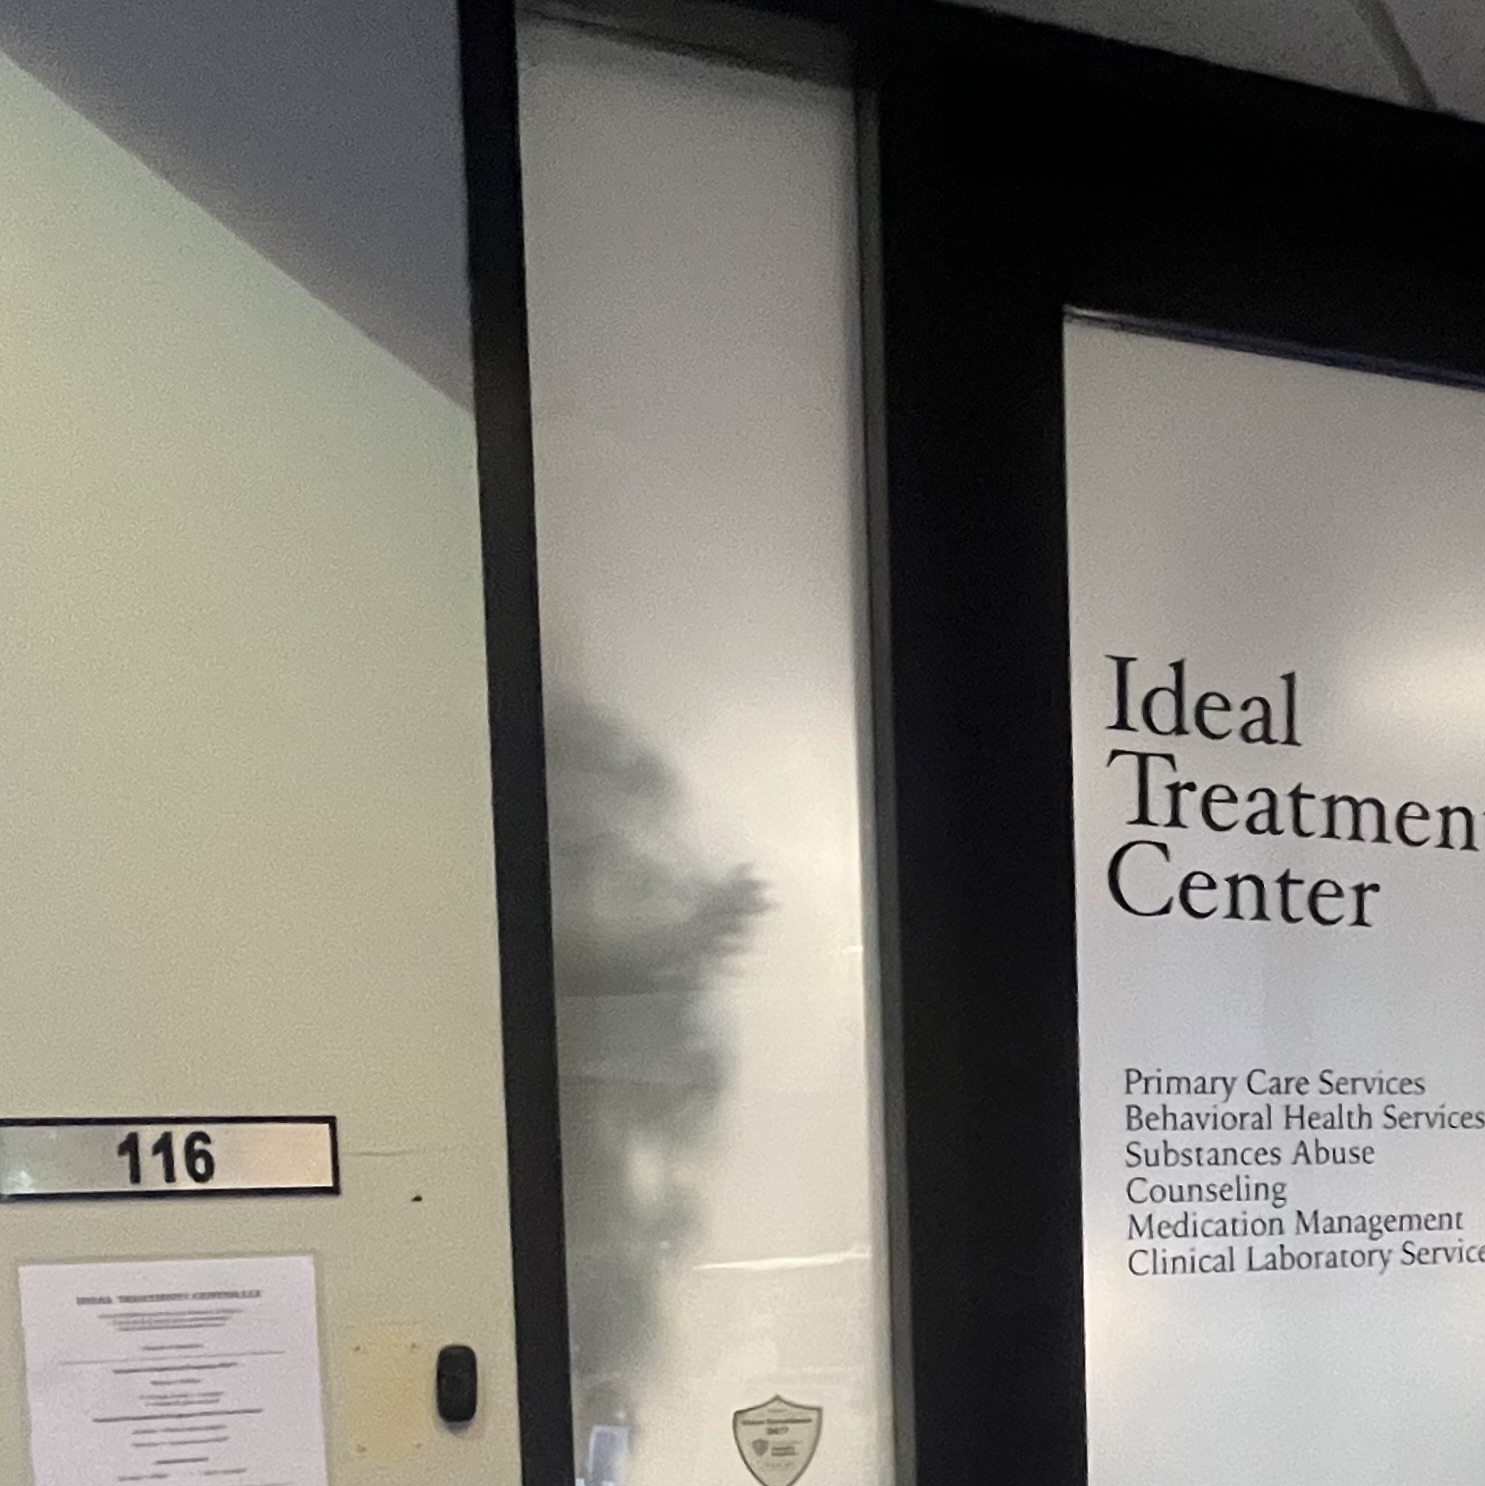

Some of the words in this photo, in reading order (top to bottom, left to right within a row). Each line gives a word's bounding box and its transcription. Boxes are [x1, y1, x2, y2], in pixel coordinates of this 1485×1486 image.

[1104, 654, 1304, 747] Ideal
[1106, 840, 1381, 928] Center
[1124, 1068, 1237, 1103] Primary
[1246, 1068, 1310, 1096] Care
[1318, 1068, 1426, 1096] Services
[1125, 1104, 1272, 1132] Behavioral
[1283, 1103, 1373, 1131] Health
[117, 1131, 216, 1184] 116
[1125, 1140, 1282, 1168] Substances
[1290, 1138, 1375, 1166] Abuse
[1126, 1175, 1288, 1208] Counseling
[1127, 1210, 1285, 1240] Medication
[1295, 1209, 1463, 1241] Management
[1127, 1245, 1235, 1277] Clinical
[1246, 1244, 1393, 1275] Laboratory
